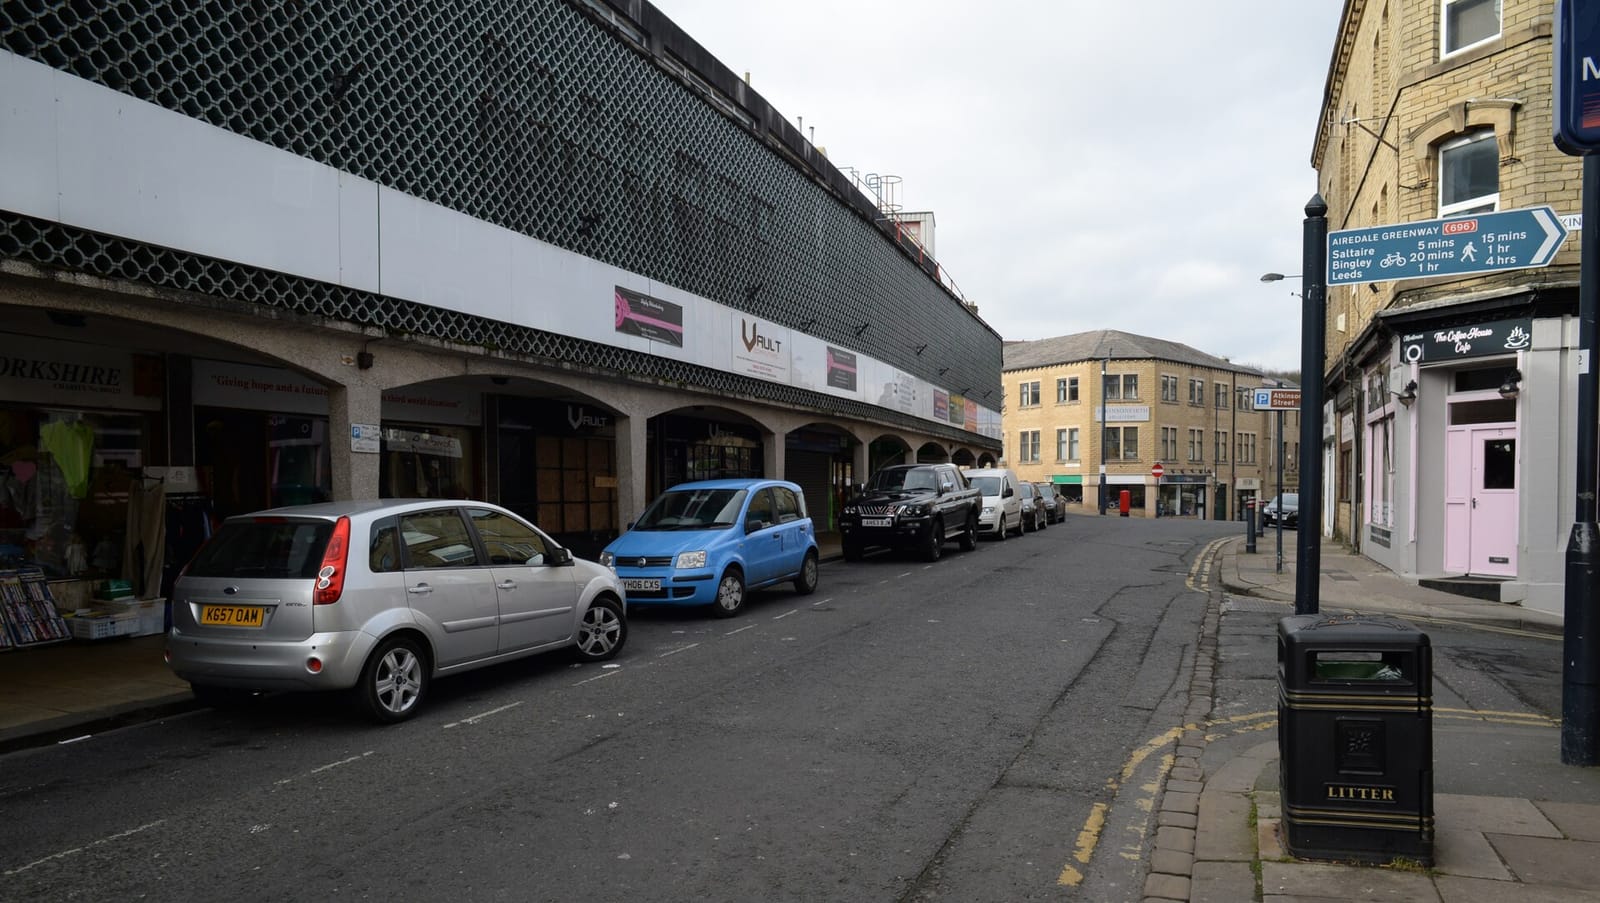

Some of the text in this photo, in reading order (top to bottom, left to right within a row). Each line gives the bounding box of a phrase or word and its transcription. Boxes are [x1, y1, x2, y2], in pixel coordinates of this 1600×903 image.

[1332, 233, 1379, 246] AIREDALE
[1382, 226, 1439, 241] GREENWAY
[1482, 231, 1527, 244] 15 mins
[1417, 239, 1455, 251] 5 mins
[1487, 244, 1510, 254] 1 hr
[1332, 247, 1375, 259] Saltaire
[1409, 250, 1455, 262] 20 mins
[1332, 259, 1372, 271] Bingley
[1485, 255, 1517, 266] 4 hrs
[1418, 262, 1440, 273] 1 hr
[1332, 270, 1363, 281] Leeds
[1433, 331, 1447, 343] The
[1447, 330, 1467, 343] Coffee
[1467, 327, 1493, 340] House
[1454, 341, 1471, 354] Cafe
[251, 379, 274, 393] hope
[276, 383, 293, 393] and
[301, 384, 329, 396] future
[623, 580, 660, 589] YH06 CXS
[236, 608, 258, 623] OAM
[1327, 786, 1394, 801] LITTER
